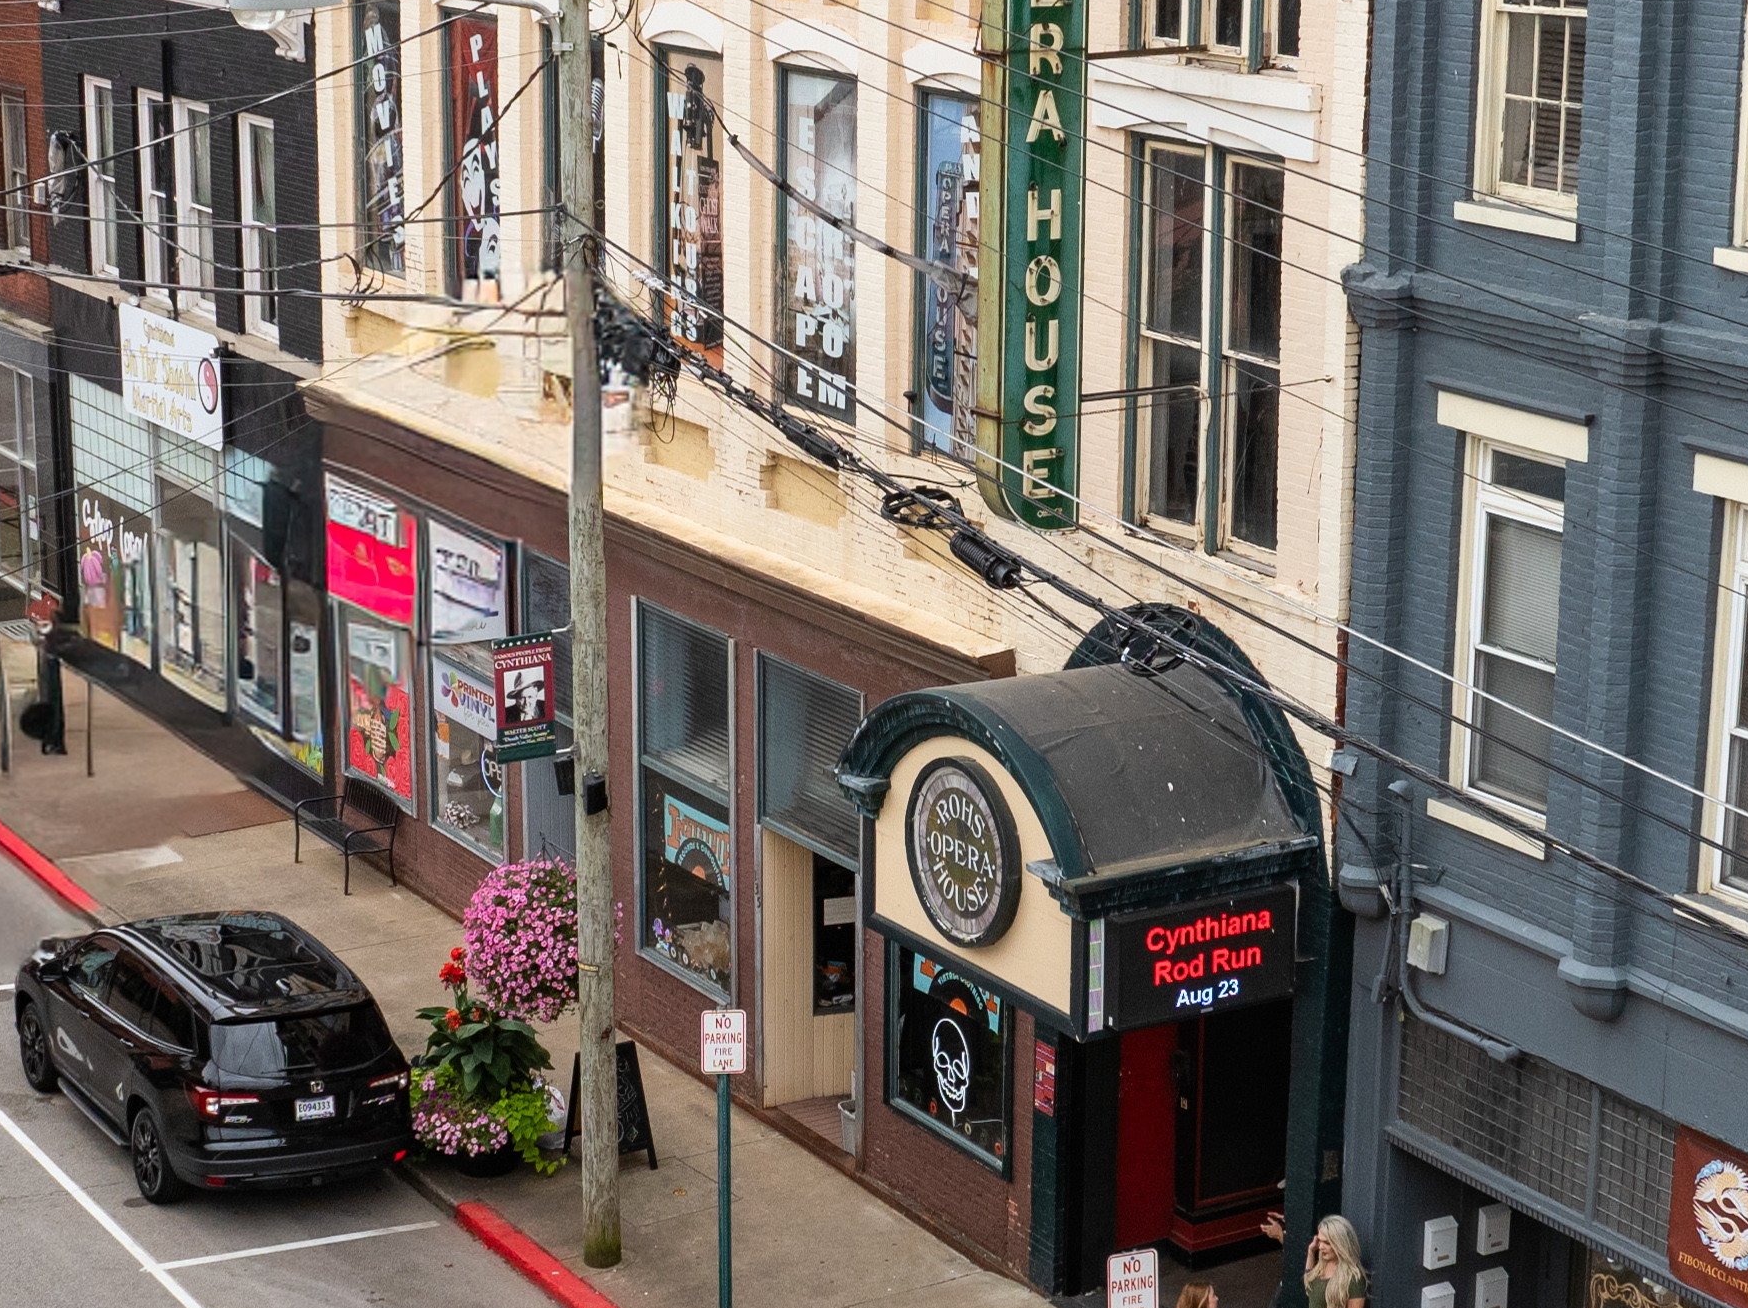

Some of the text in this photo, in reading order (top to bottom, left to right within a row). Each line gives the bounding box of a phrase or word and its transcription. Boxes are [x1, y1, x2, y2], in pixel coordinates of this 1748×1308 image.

[365, 22, 405, 244] MOVIES
[469, 33, 500, 206] PLAYS
[794, 116, 817, 398] ESCAPE
[817, 221, 847, 410] ROOM
[1021, 188, 1065, 500] HOUSE
[169, 396, 193, 433] Arts
[82, 498, 114, 558] Shop
[494, 652, 552, 670] CYNTHIANA
[456, 678, 495, 708] PRINTED
[459, 693, 495, 723] VINYL
[935, 793, 986, 839] ROHS
[930, 830, 994, 879] OPERA
[933, 859, 989, 912] HOUSE
[1146, 909, 1271, 955] Cynthiana
[1154, 946, 1262, 986] Rod Run
[1176, 978, 1239, 1008] Aug 23
[705, 1032, 742, 1045] PARKING
[715, 1017, 732, 1030] NO
[713, 1059, 734, 1068] LANE
[714, 1047, 733, 1056] FIRE
[1123, 1259, 1141, 1275] NO
[1678, 1251, 1727, 1281] FIBONACCI
[1111, 1275, 1153, 1294] PARKING
[1122, 1294, 1143, 1307] FIRE
